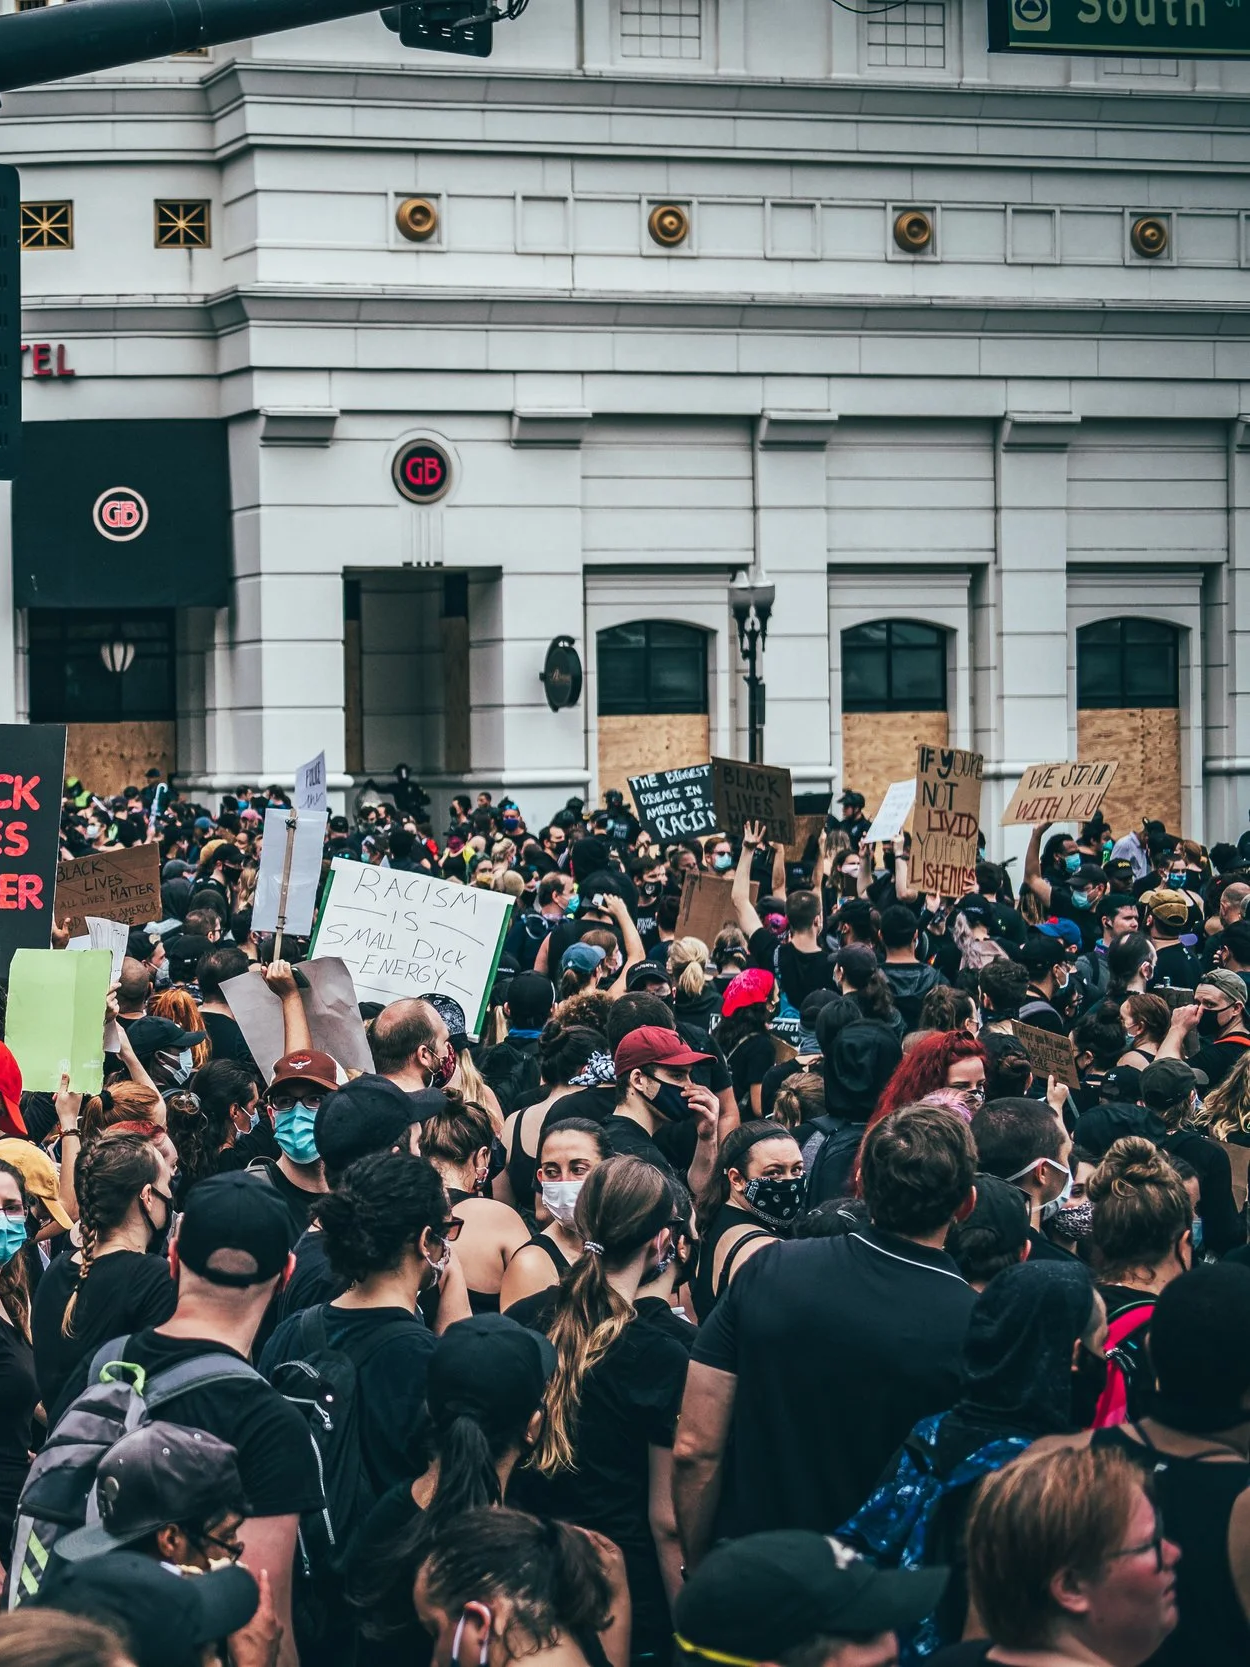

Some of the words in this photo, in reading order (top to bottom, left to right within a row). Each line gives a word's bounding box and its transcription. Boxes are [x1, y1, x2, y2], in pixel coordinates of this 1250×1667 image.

[1077, 0, 1206, 27] South
[405, 456, 442, 485] GB
[101, 500, 140, 528] GB
[919, 746, 935, 774] IF
[628, 774, 659, 792] THE
[723, 766, 781, 799] BLACK
[1029, 765, 1061, 790] WE
[684, 784, 703, 799] IN
[724, 790, 774, 817] LIVES
[922, 780, 958, 811] NOT
[1015, 796, 1064, 821] WITH
[1065, 791, 1102, 818] YOU
[927, 809, 978, 842] LIVID
[56, 860, 104, 883] BLACK
[84, 874, 123, 892] LIVES
[60, 900, 77, 909] ALL
[81, 894, 106, 906] LIVES
[110, 882, 156, 901] MATTER
[353, 867, 478, 915] RACISM
[118, 901, 157, 919] AMERICA
[392, 910, 419, 932] IS
[322, 923, 397, 951] SMALL
[412, 938, 468, 969] DICK
[359, 954, 447, 990] ENERGY
